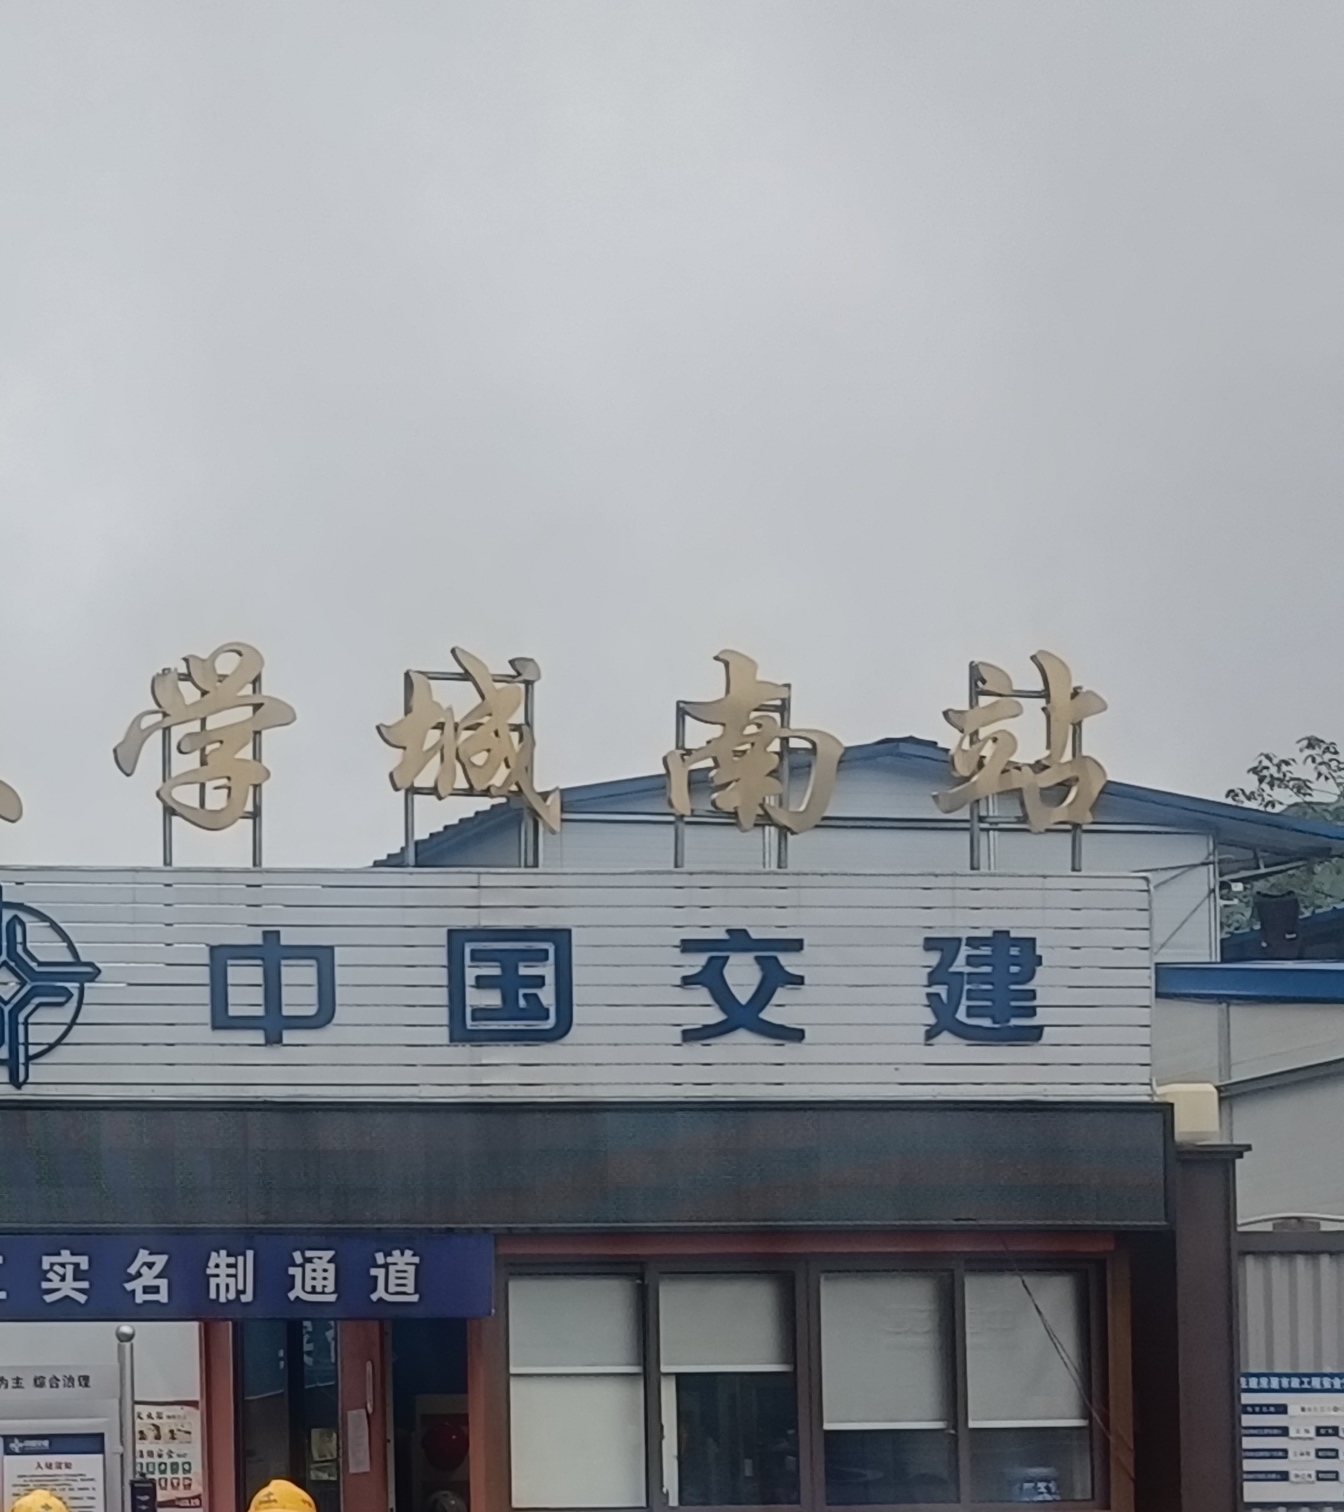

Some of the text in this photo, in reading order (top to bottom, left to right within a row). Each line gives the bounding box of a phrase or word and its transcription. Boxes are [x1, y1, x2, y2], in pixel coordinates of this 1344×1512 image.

[209, 926, 1045, 1045] 中国交建
[33, 1374, 91, 1389] 综合治理
